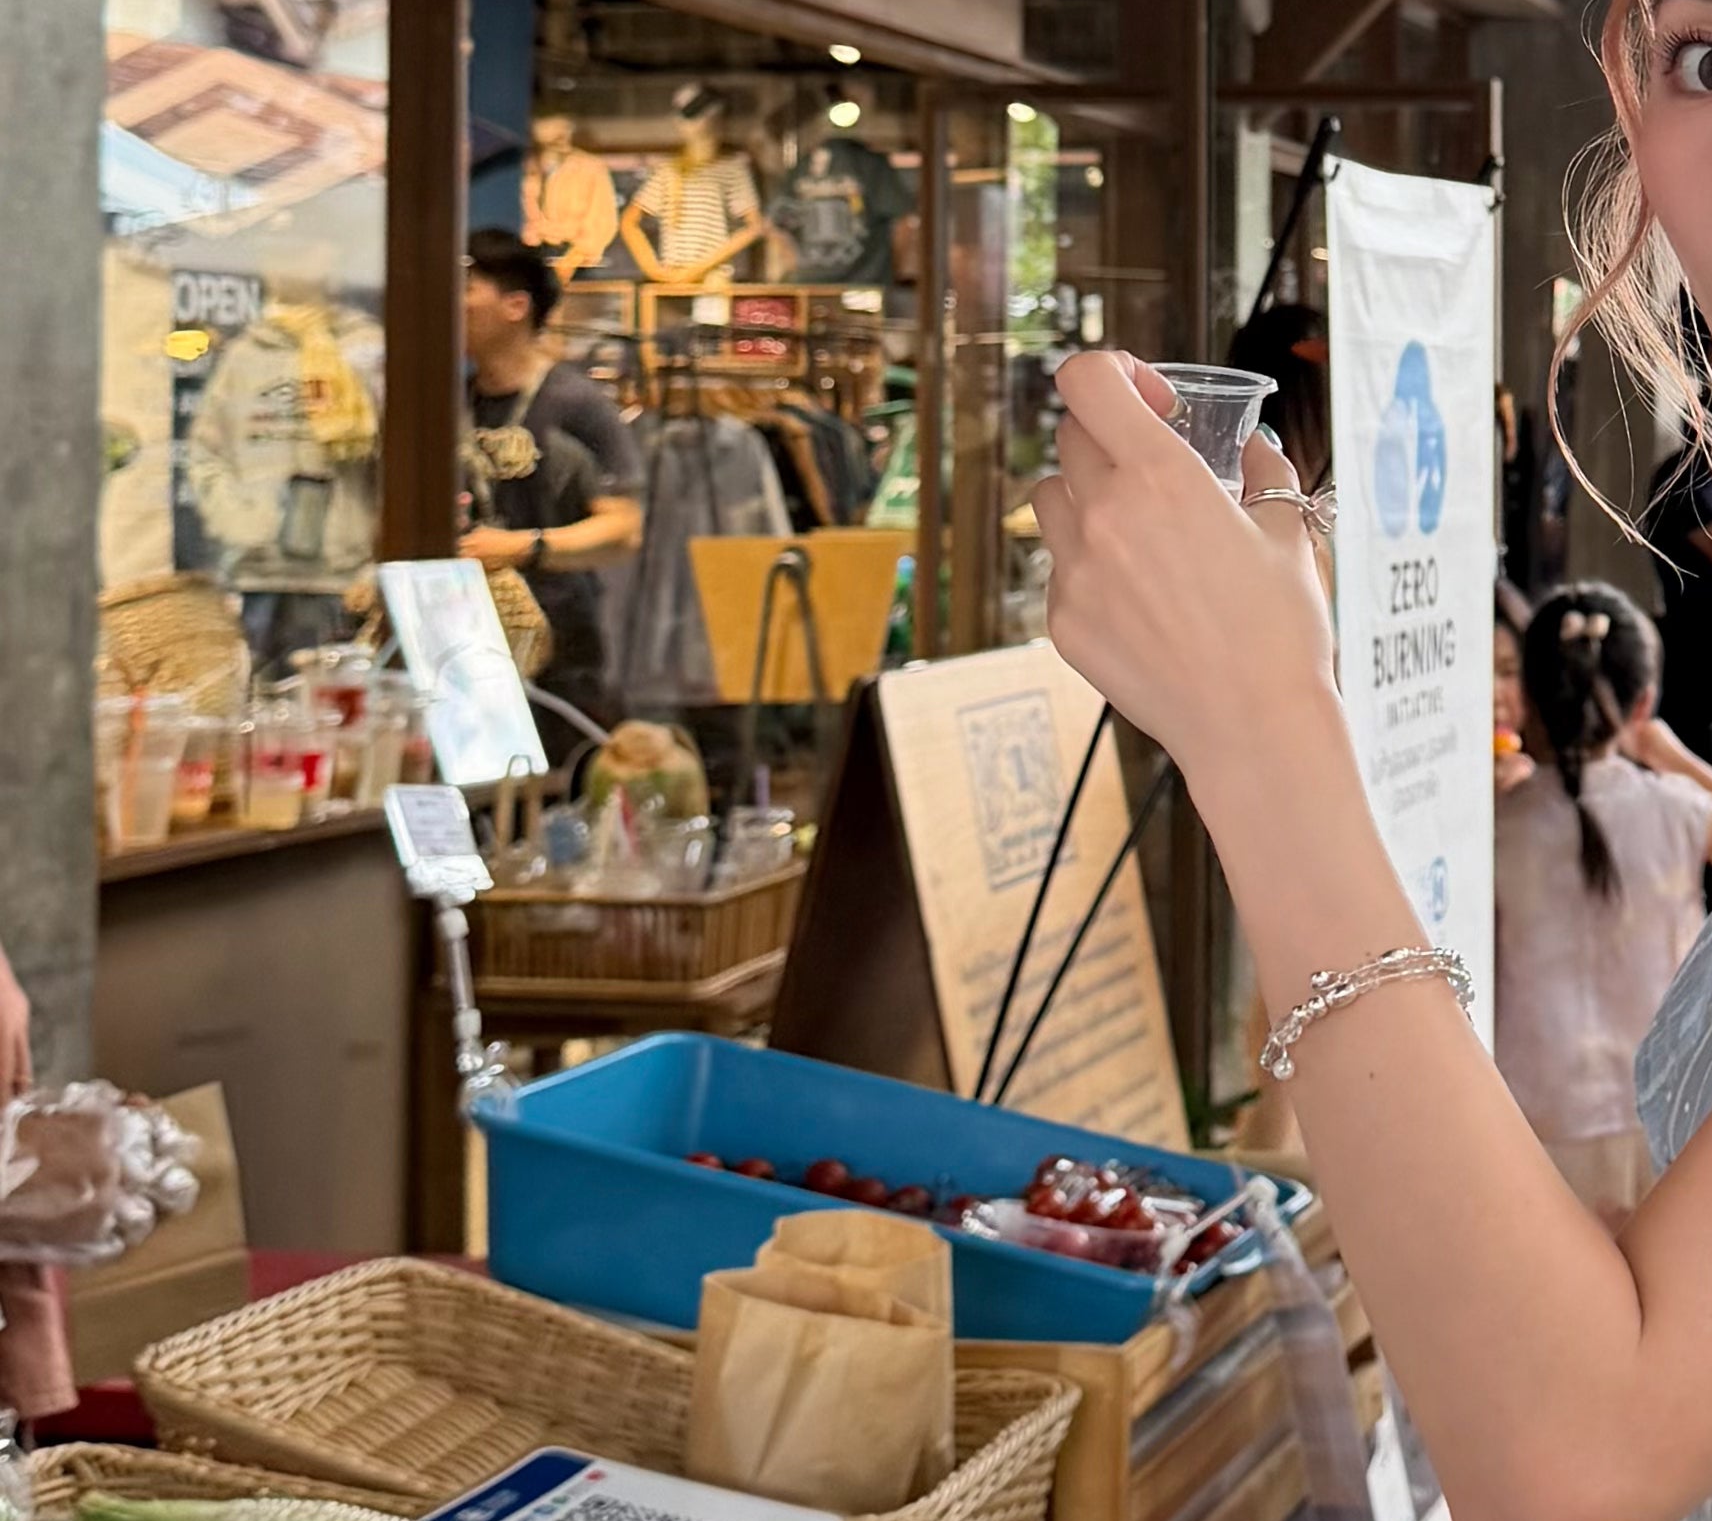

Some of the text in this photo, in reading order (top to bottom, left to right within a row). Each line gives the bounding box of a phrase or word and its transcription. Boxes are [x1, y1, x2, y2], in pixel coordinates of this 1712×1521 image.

[173, 274, 261, 322] OPEN
[1390, 556, 1440, 615] ZERO
[1373, 618, 1456, 689] BURNING
